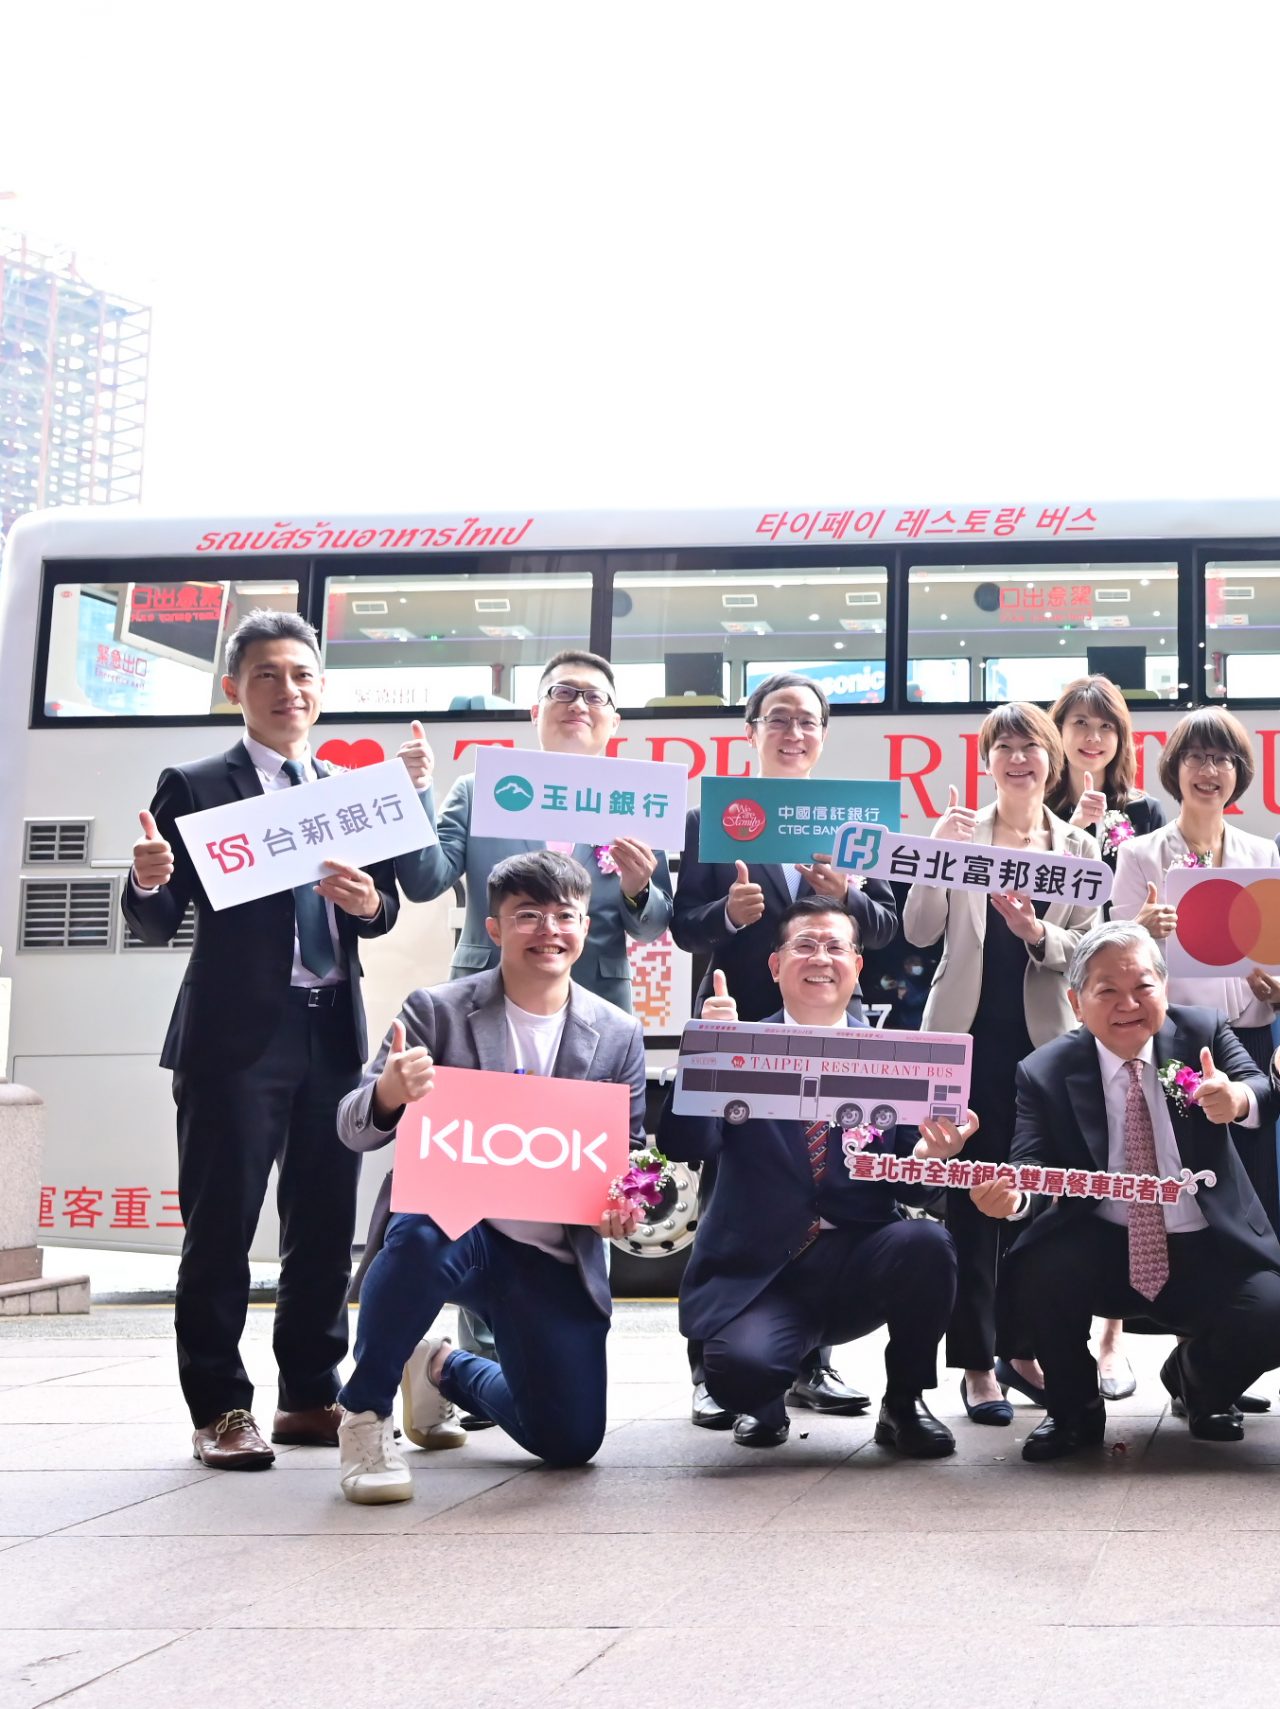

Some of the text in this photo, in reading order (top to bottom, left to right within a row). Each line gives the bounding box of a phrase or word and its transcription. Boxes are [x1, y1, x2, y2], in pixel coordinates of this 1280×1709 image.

[756, 505, 1099, 541] 타이페이 레스토랑 버스
[541, 784, 669, 818] 玉山銀行
[778, 805, 880, 822] 中國信託銀行
[263, 794, 404, 857] 台新銀行
[778, 825, 838, 836] CTBC BAN
[890, 845, 1103, 900] 台北富邦銀行
[751, 1057, 953, 1078] TAIPEI RESTAURANT BUS
[420, 1116, 607, 1172] KLOOK
[853, 1155, 1183, 1203] 臺北市全新銀色雙層餐車記者會
